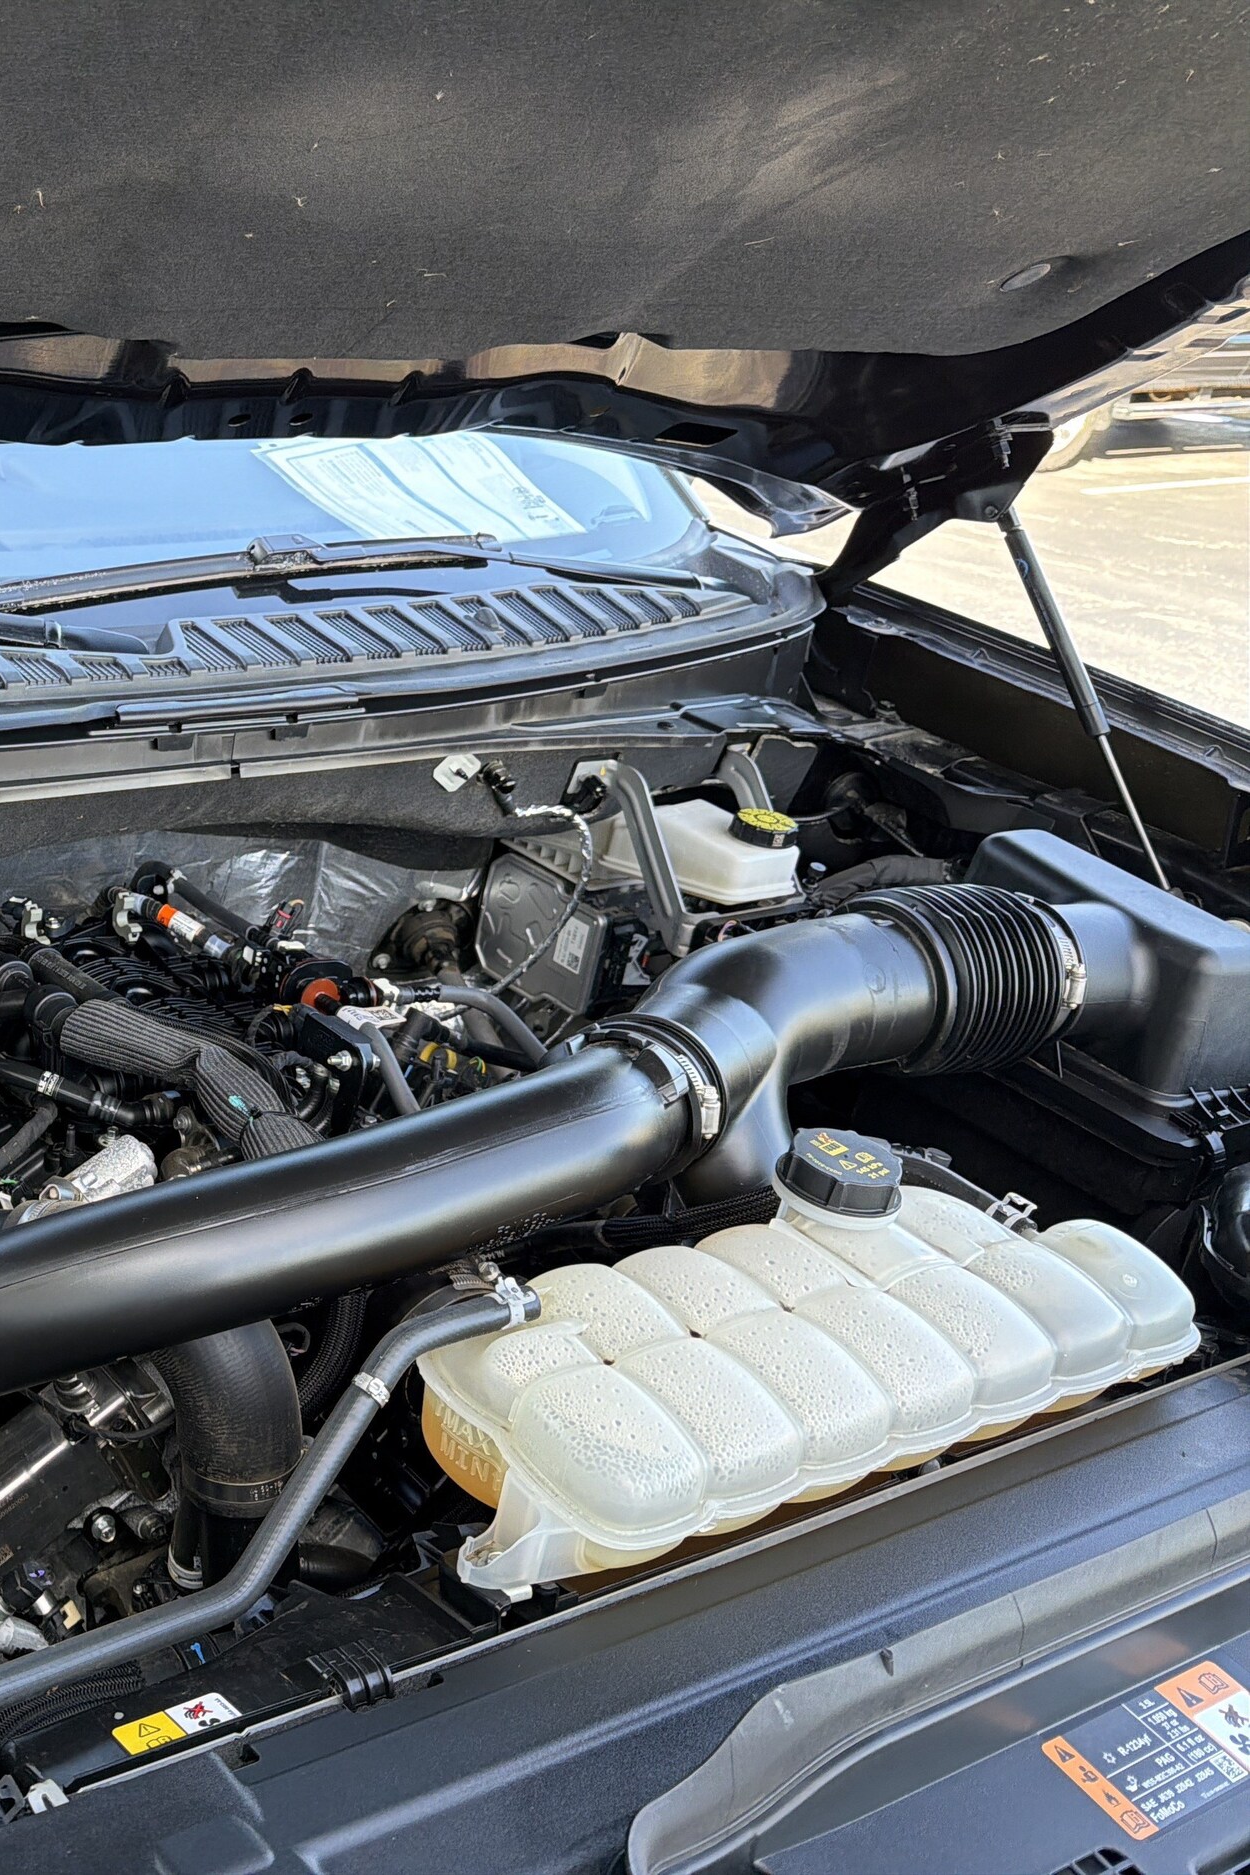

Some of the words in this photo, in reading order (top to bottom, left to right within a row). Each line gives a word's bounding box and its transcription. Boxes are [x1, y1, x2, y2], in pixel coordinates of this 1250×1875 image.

[442, 1406, 491, 1455] MAX
[440, 1431, 490, 1482] MIN
[1164, 1708, 1178, 1718] kg
[1117, 1734, 1152, 1757] R-1234yf
[1195, 1734, 1205, 1743] oz
[1155, 1753, 1175, 1767] PAG
[1141, 1798, 1159, 1811] SAE
[1150, 1800, 1185, 1822] FoMoCo
